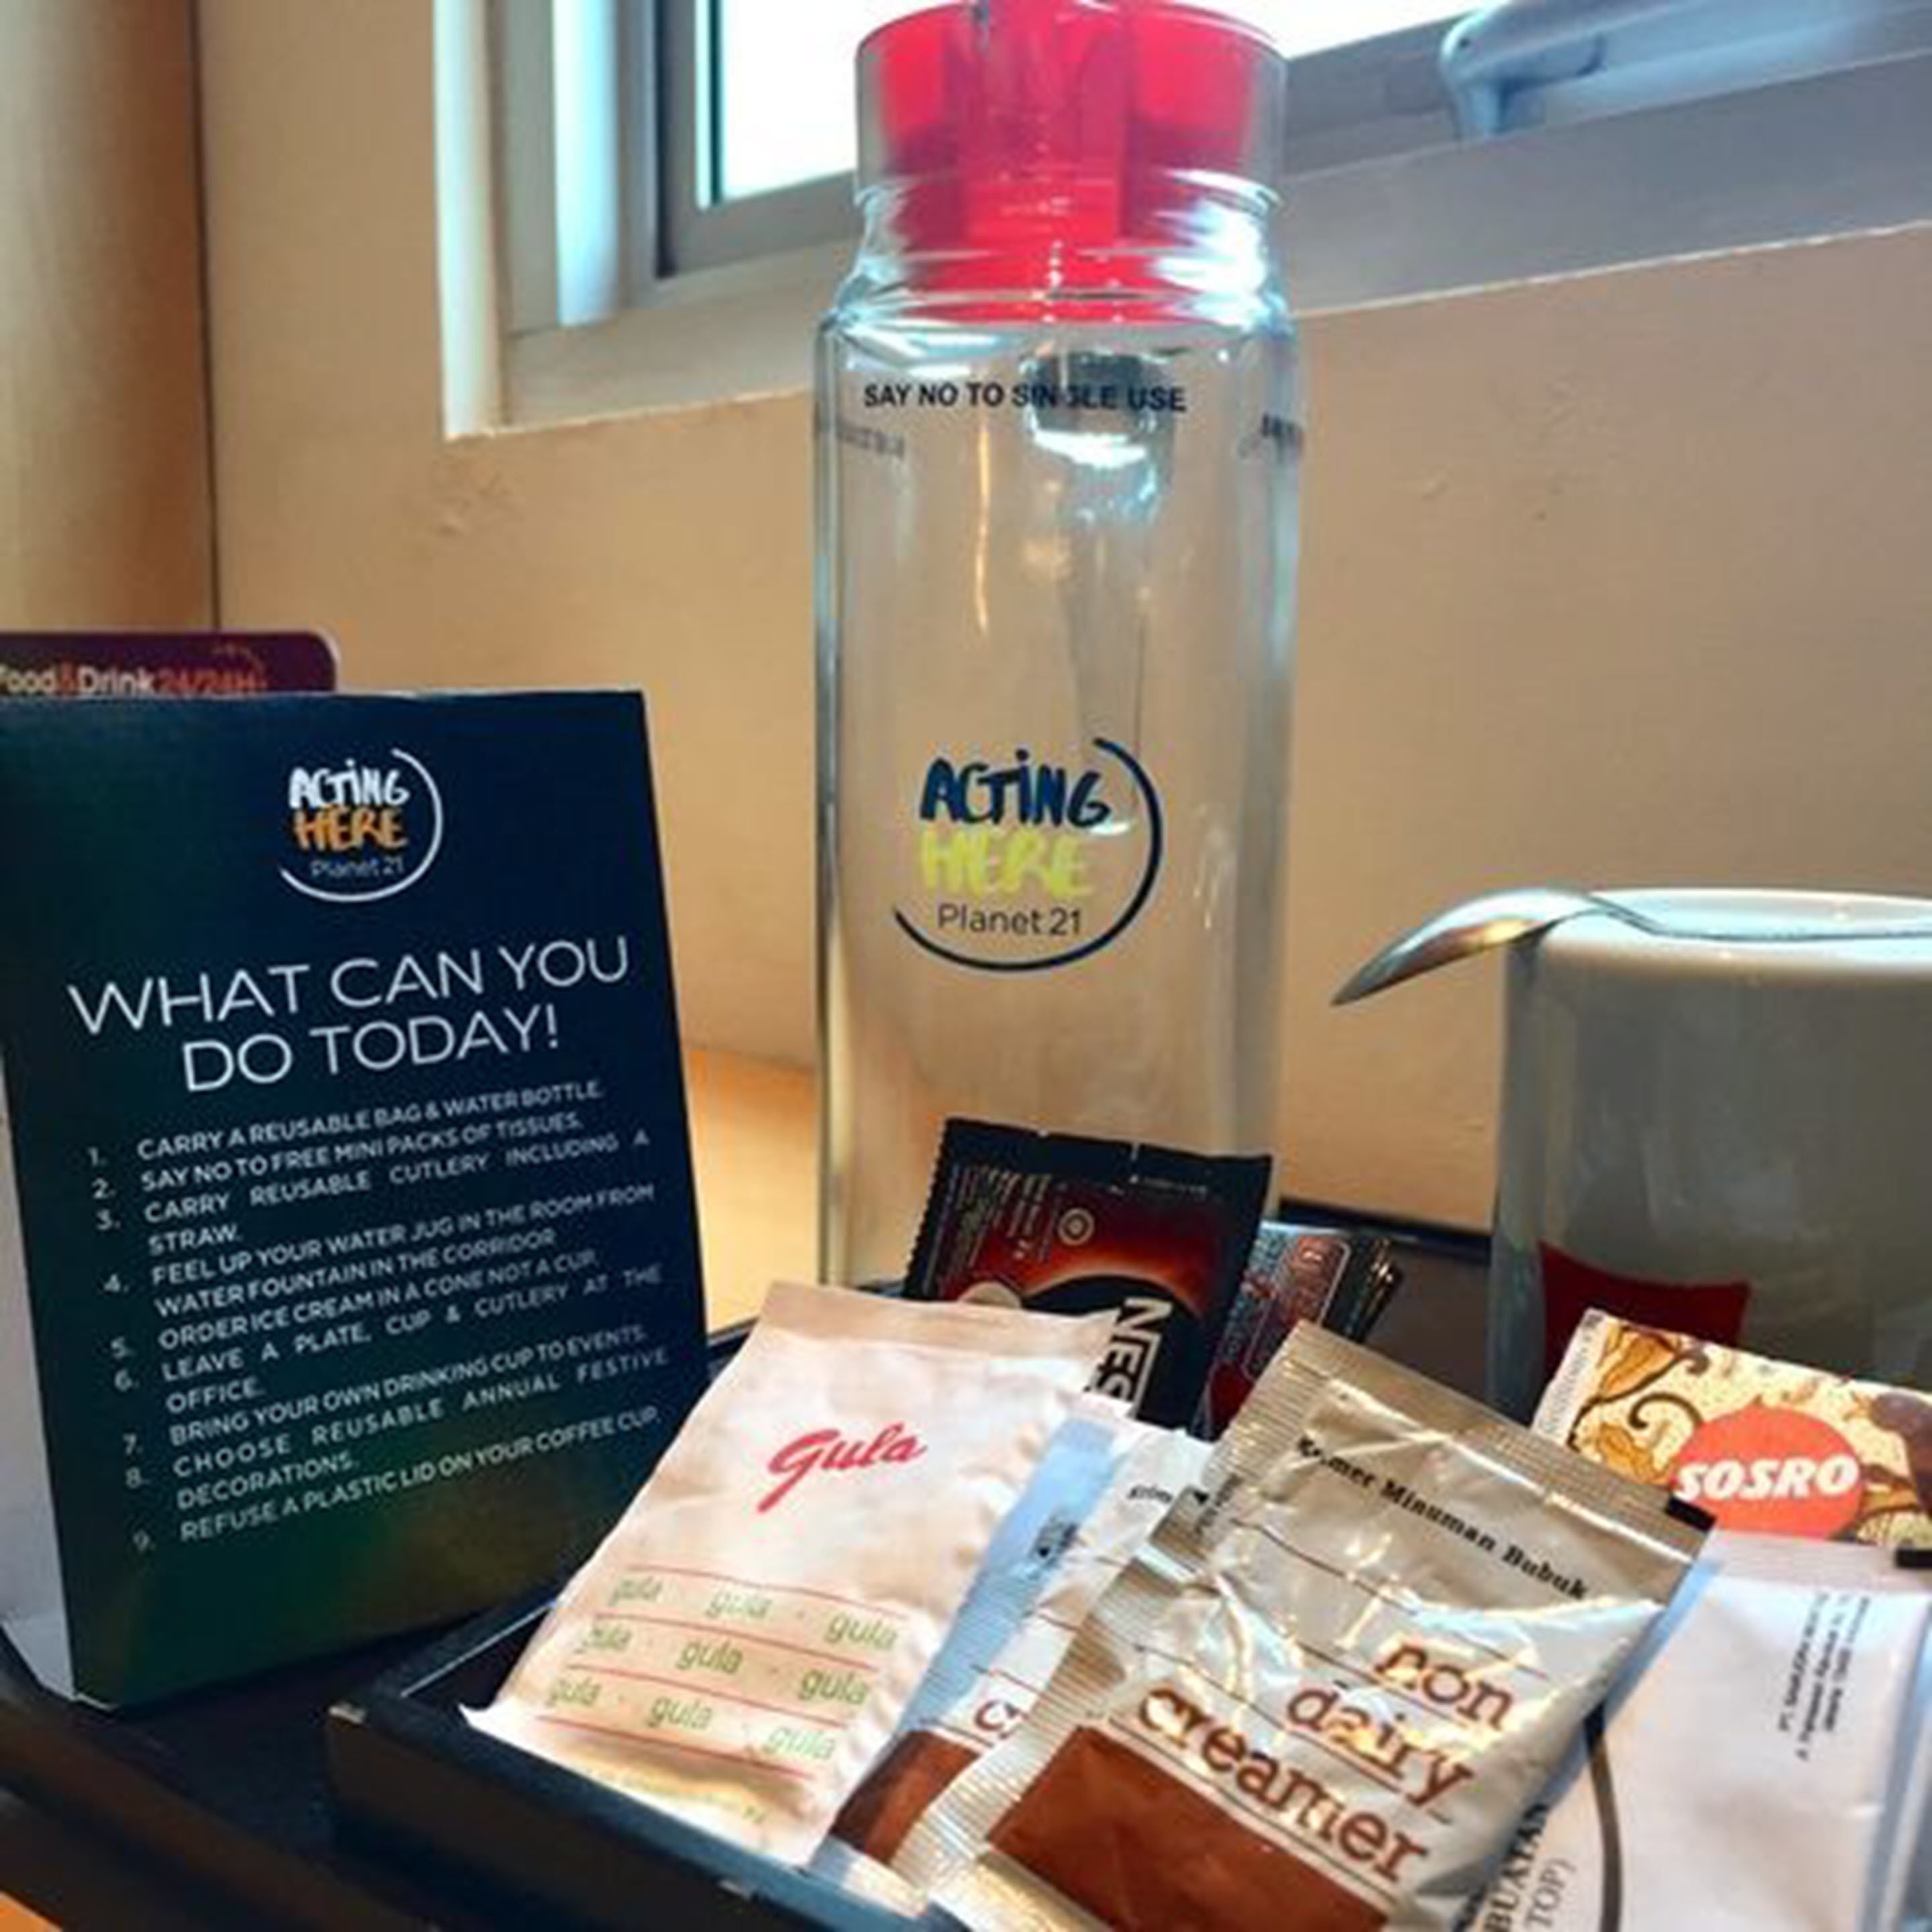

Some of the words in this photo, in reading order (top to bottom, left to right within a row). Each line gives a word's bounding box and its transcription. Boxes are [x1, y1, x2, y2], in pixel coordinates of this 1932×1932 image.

[864, 383, 912, 407] SAY
[918, 384, 959, 407] NO
[966, 383, 1004, 406] TO
[1128, 385, 1187, 411] USE
[294, 805, 409, 851] HERE
[922, 829, 1093, 897] HERE
[937, 903, 1045, 934] Planet
[1050, 907, 1081, 936] 21
[68, 964, 309, 1034] WHAT
[331, 949, 484, 1008] CAN
[498, 937, 629, 989] YOU
[183, 1034, 293, 1091] DO
[309, 1004, 559, 1074] TODAY!
[137, 1130, 223, 1161] CARRY
[227, 1128, 245, 1147] A
[250, 1108, 371, 1143] REUSABLE
[374, 1103, 421, 1128] BAG
[425, 1102, 439, 1120] &
[443, 1090, 518, 1116] WATER
[141, 1167, 189, 1192] SAY
[193, 1161, 233, 1184] NO
[235, 1155, 268, 1177] TO
[272, 1146, 329, 1171] FREE
[335, 1137, 383, 1162] MINI
[387, 1126, 459, 1155] PACKS
[462, 1122, 491, 1143] OF
[144, 1192, 230, 1222] CARRY
[250, 1170, 372, 1207] REUSABLE
[388, 1152, 490, 1184] CUTLERY
[505, 1132, 620, 1166] INCLUDING
[634, 1128, 649, 1144] A
[152, 1258, 215, 1286] FEEL
[219, 1251, 252, 1273] UP
[256, 1238, 322, 1266] YOUR
[326, 1225, 405, 1254] WATER
[411, 1216, 453, 1242] JUG
[458, 1212, 480, 1233] IN
[485, 1204, 525, 1228] THE
[529, 1195, 592, 1220] ROOM
[596, 1183, 655, 1207] FROM
[154, 1285, 245, 1317] WATER
[248, 1262, 366, 1299] FOUNTAIN
[370, 1256, 393, 1277] IN
[397, 1246, 439, 1272] THE
[442, 1227, 557, 1265] CORRIDOR
[158, 1316, 249, 1349] ORDER
[250, 1306, 290, 1330] ICE
[292, 1289, 375, 1322] CREAM
[378, 1285, 400, 1307] IN
[405, 1282, 421, 1301] A
[424, 1270, 484, 1297] CONE
[488, 1260, 532, 1285] NOT
[537, 1256, 551, 1275] A
[161, 1347, 245, 1381] LEAVE
[262, 1342, 280, 1362] A
[385, 1309, 431, 1336] CUP
[445, 1305, 461, 1323] &
[475, 1284, 569, 1318] CUTLERY
[583, 1273, 607, 1295] AT
[623, 1263, 663, 1287] THE
[170, 1412, 249, 1448] BRING
[254, 1395, 319, 1427] YOUR
[323, 1382, 380, 1411] OWN
[383, 1356, 489, 1398] DRINKING
[491, 1347, 535, 1373] CUP
[537, 1340, 566, 1362] TO
[172, 1433, 291, 1478] CHOOSE
[311, 1397, 445, 1446] REUSABLE
[462, 1373, 561, 1410] ANNUAL
[576, 1346, 669, 1383] FESTIVE
[180, 1500, 278, 1542] REFUSE
[282, 1497, 300, 1516] A
[303, 1471, 399, 1512] PLASTIC
[401, 1462, 437, 1487] LID
[439, 1454, 472, 1477] ON
[477, 1437, 535, 1466] YOUR
[536, 1415, 616, 1452] COFFEE
[757, 1421, 928, 1513] Gula
[1675, 1454, 1860, 1501] SOSRO
[1380, 1479, 1497, 1552] Minuman
[1501, 1543, 1591, 1601] Bubuk
[706, 1586, 773, 1619] gula
[824, 1611, 900, 1652] gula
[676, 1640, 744, 1674] gula
[797, 1667, 869, 1706] gula
[1375, 1643, 1517, 1731] non
[646, 1692, 714, 1731] gula
[762, 1723, 837, 1762] gula
[1286, 1686, 1475, 1807] dairy
[1139, 1686, 1430, 1882] creamer
